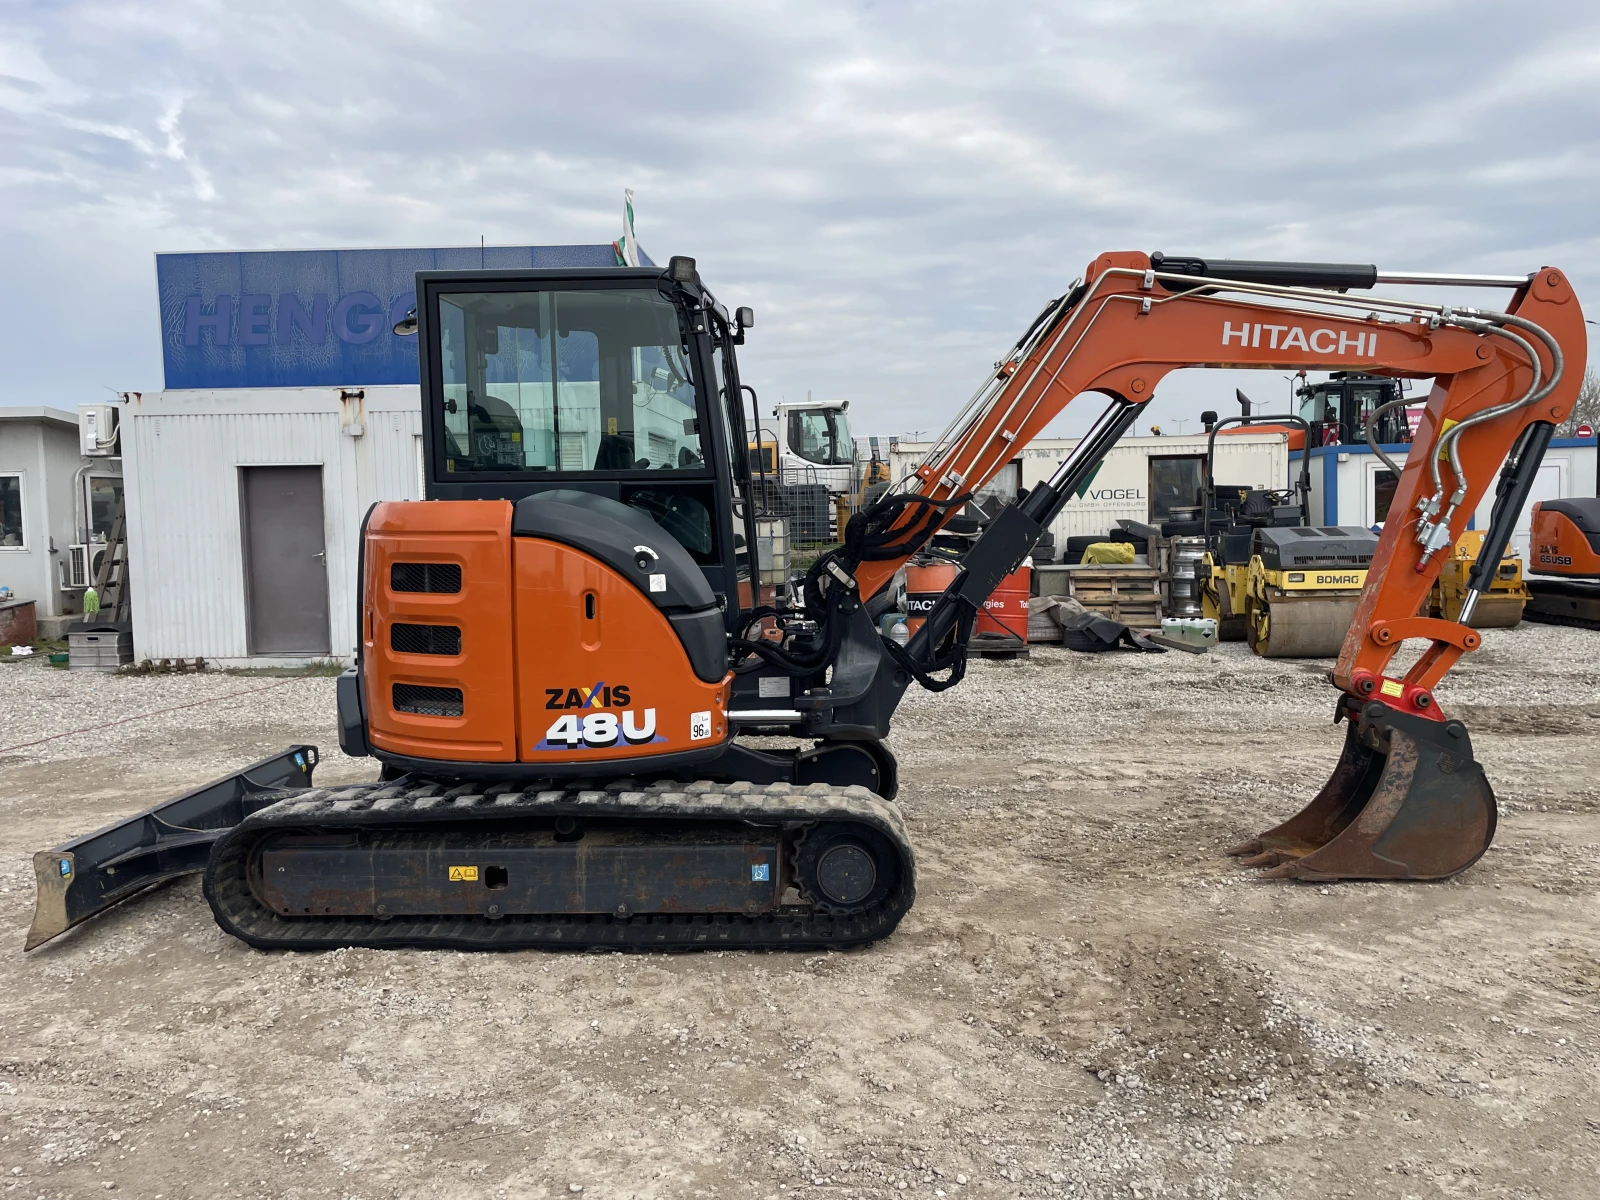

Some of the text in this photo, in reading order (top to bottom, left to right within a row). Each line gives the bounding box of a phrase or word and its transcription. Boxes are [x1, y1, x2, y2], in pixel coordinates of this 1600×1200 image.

[1222, 321, 1377, 357] HITACHI
[1090, 489, 1146, 500] VOGEL
[1540, 544, 1558, 554] ZAXIS
[1540, 555, 1572, 566] 65USB
[1316, 575, 1359, 584] BOMAG
[545, 681, 631, 710] ZAXIS
[546, 708, 656, 749] 48U
[693, 724, 704, 737] 96
